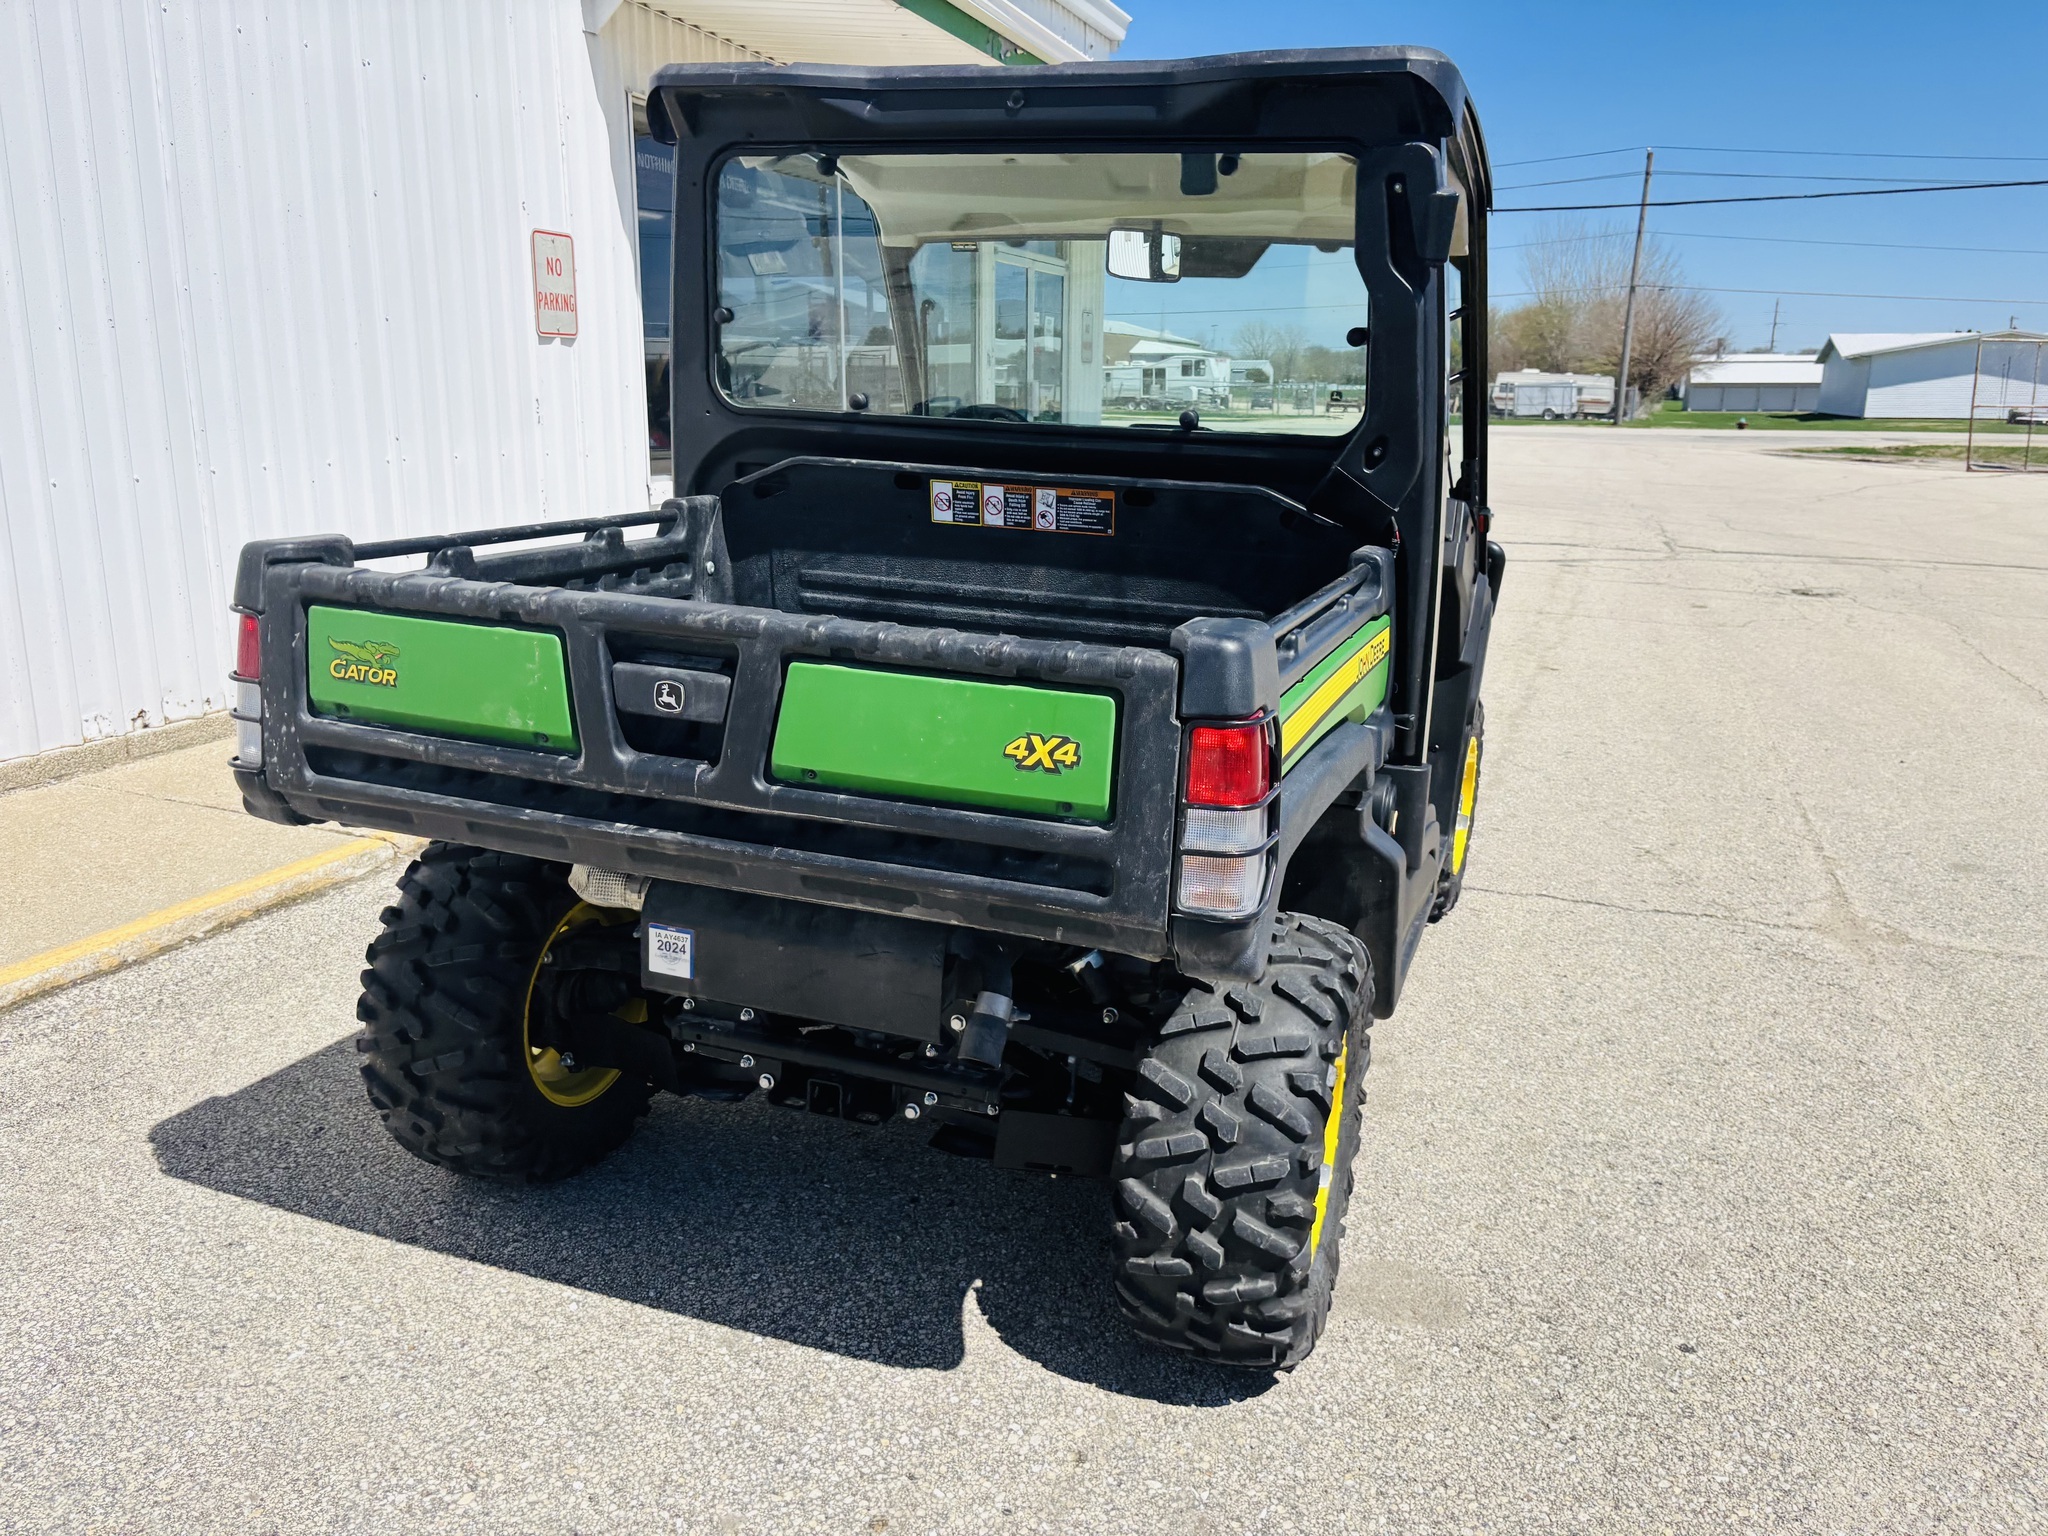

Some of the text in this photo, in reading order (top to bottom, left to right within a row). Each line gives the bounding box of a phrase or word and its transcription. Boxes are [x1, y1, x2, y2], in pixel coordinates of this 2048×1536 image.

[637, 152, 674, 173] NOTHIN
[546, 257, 562, 277] NO
[538, 291, 575, 313] PARKING
[1370, 638, 1385, 669] DEERE
[329, 658, 397, 687] GATOR
[657, 939, 687, 955] 2024
[664, 934, 688, 943] AY4637
